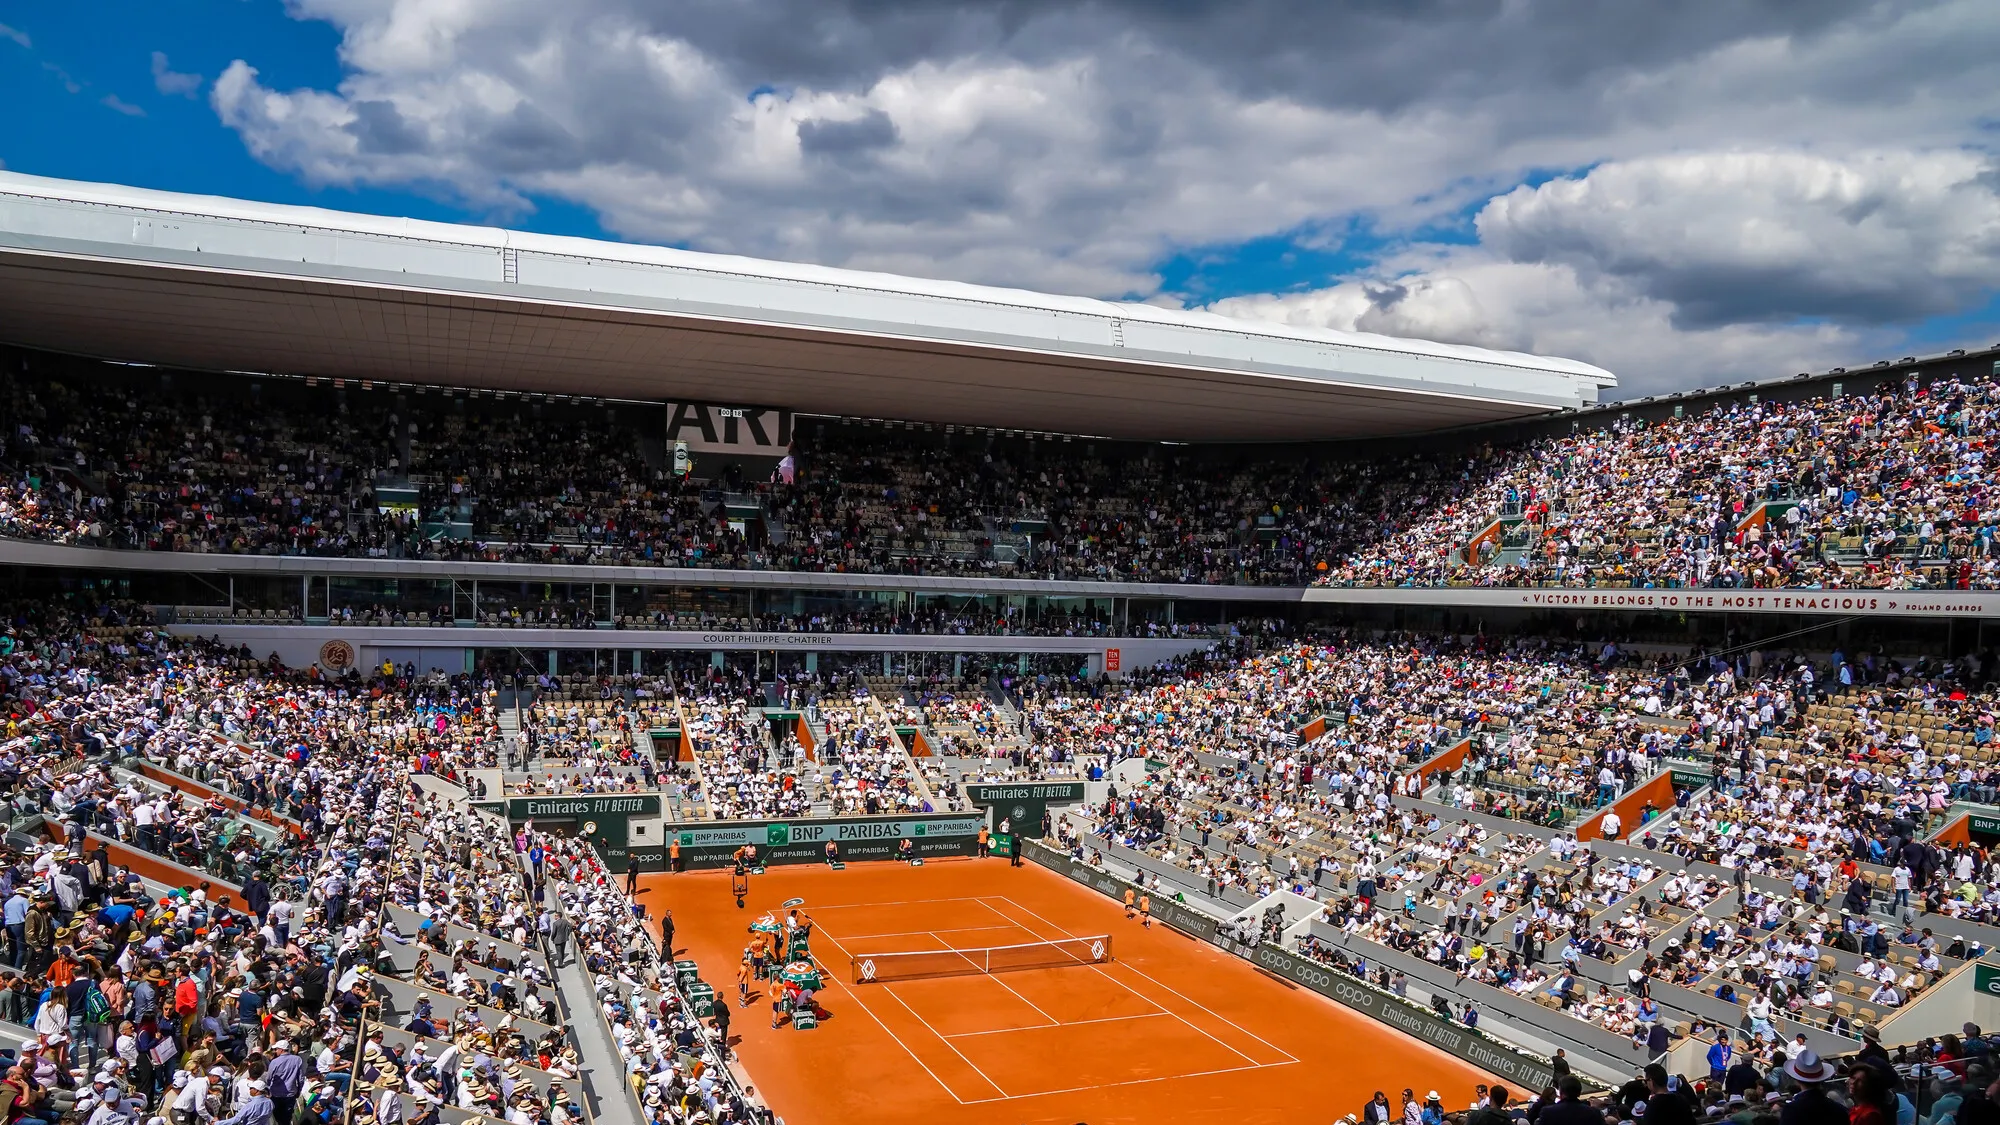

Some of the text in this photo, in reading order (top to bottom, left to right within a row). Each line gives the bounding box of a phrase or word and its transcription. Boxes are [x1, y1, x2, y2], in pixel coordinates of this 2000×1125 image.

[1533, 594, 1587, 604] VICTORY
[1593, 595, 1654, 606] BELONGS
[1661, 596, 1678, 606] TO
[1686, 597, 1713, 607] THE
[1722, 597, 1765, 608] MOST
[1773, 597, 1878, 610] TENACIOUS
[1905, 604, 1982, 613] ROLAND GARROS
[703, 634, 735, 643] COURT
[738, 635, 779, 644] PHILIPPE
[787, 636, 832, 644] CHATRIER
[1674, 773, 1688, 781] BNP
[980, 785, 1072, 800] Emirates FLY BETTER
[527, 798, 643, 815] Emirates FLY BETTER
[792, 823, 902, 841] BNP PARIBAS
[944, 822, 973, 830] PARIBAS
[1974, 819, 1995, 830] BNP
[695, 831, 746, 841] BNP PARIBAS
[709, 853, 734, 861] PARIBA
[1136, 896, 1164, 914] RAULT
[1175, 913, 1207, 933] RENAULT
[1260, 949, 1292, 971] oppo
[1296, 965, 1330, 987] oppo
[1335, 982, 1373, 1007] oppo
[1381, 1002, 1462, 1049] Emirates FLY BETTER
[1467, 1041, 1516, 1074] Emirates
[1517, 1064, 1534, 1082] FLY
